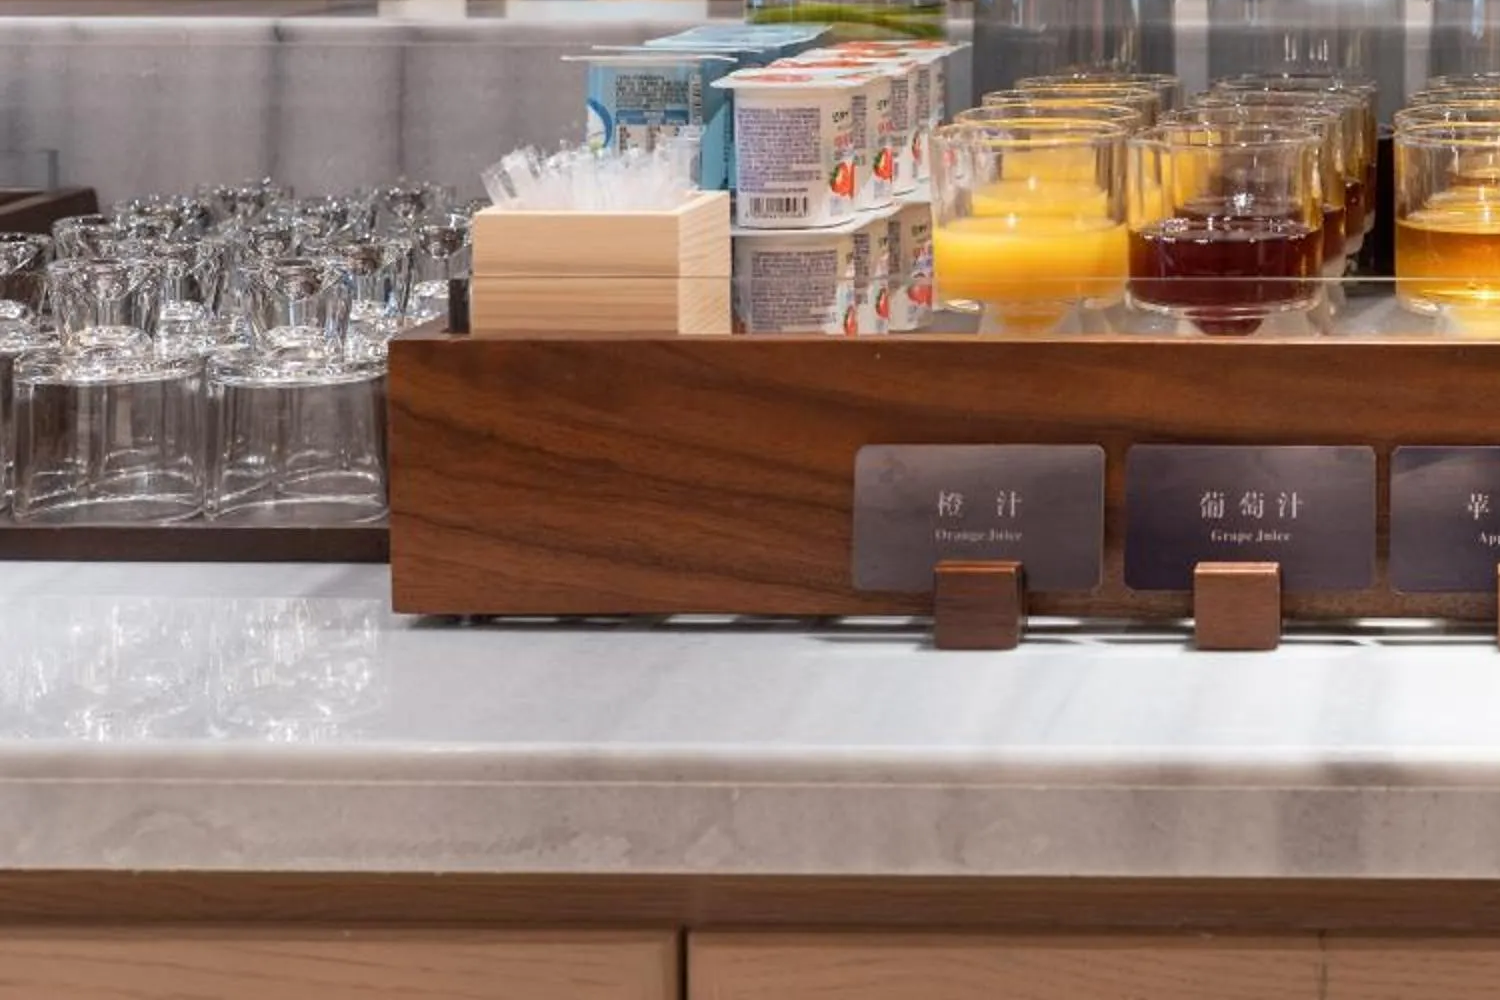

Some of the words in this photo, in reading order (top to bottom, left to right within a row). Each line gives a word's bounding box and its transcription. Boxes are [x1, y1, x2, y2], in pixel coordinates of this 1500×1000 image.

[937, 490, 1022, 517] 橙汁
[1199, 491, 1303, 518] 葡萄汁
[935, 529, 984, 541] Orange
[989, 529, 1022, 541] Juice
[1210, 530, 1252, 544] Grape
[1255, 530, 1290, 543] Juice
